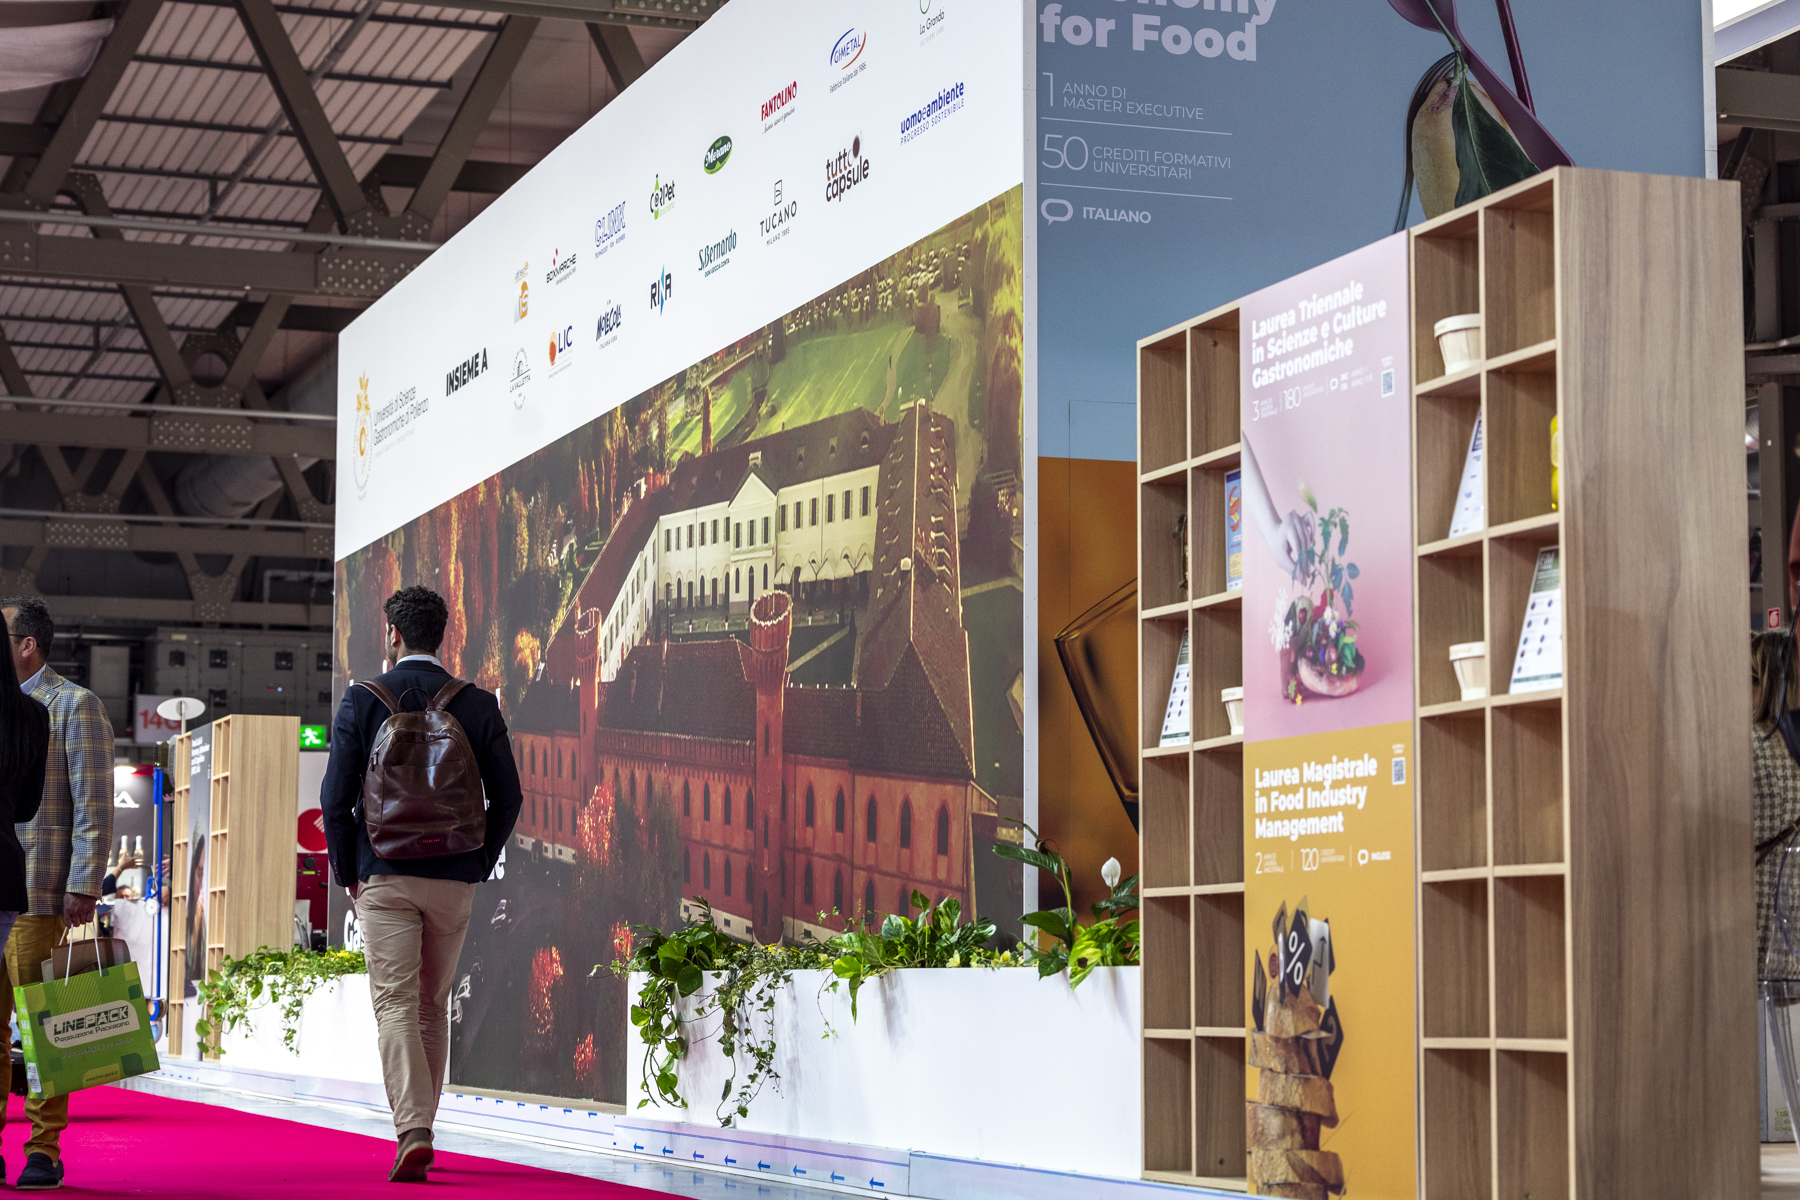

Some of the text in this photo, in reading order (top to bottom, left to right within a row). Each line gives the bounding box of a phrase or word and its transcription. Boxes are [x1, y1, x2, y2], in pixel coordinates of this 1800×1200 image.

[919, 11, 945, 35] La Granda
[1039, 3, 1116, 48] for
[1132, 13, 1257, 61] Food
[761, 80, 798, 122] FANTOLINO
[1042, 71, 1054, 107] 1
[1062, 82, 1126, 100] ANNO DI
[900, 82, 965, 135] uomoeambiente
[900, 98, 965, 146] PROGRESSO SOSTENIBILE
[1063, 96, 1204, 120] MASTER EXECUTIVE
[1041, 133, 1089, 171] 50
[1092, 146, 1231, 169] CREDITI FORMATIVI
[825, 155, 870, 203] capsule
[1093, 160, 1192, 180] UNIVERSITARI
[759, 200, 798, 237] TUCANO
[1082, 206, 1151, 224] ITALIANO
[766, 232, 781, 246] MILANO
[1251, 279, 1364, 341] Laurea Triennale
[558, 325, 573, 354] LIC
[1251, 299, 1387, 365] in Scienze e Culture
[446, 347, 489, 398] INSIEME A
[1251, 337, 1354, 389] Gastronomiche
[1252, 400, 1260, 422] 3
[1283, 386, 1301, 411] 180
[1255, 753, 1378, 789] Laurea Magistrale
[1255, 784, 1368, 814] in Food Industry
[1255, 811, 1344, 842] Management
[1255, 852, 1263, 874] 2
[1300, 848, 1319, 871] 120
